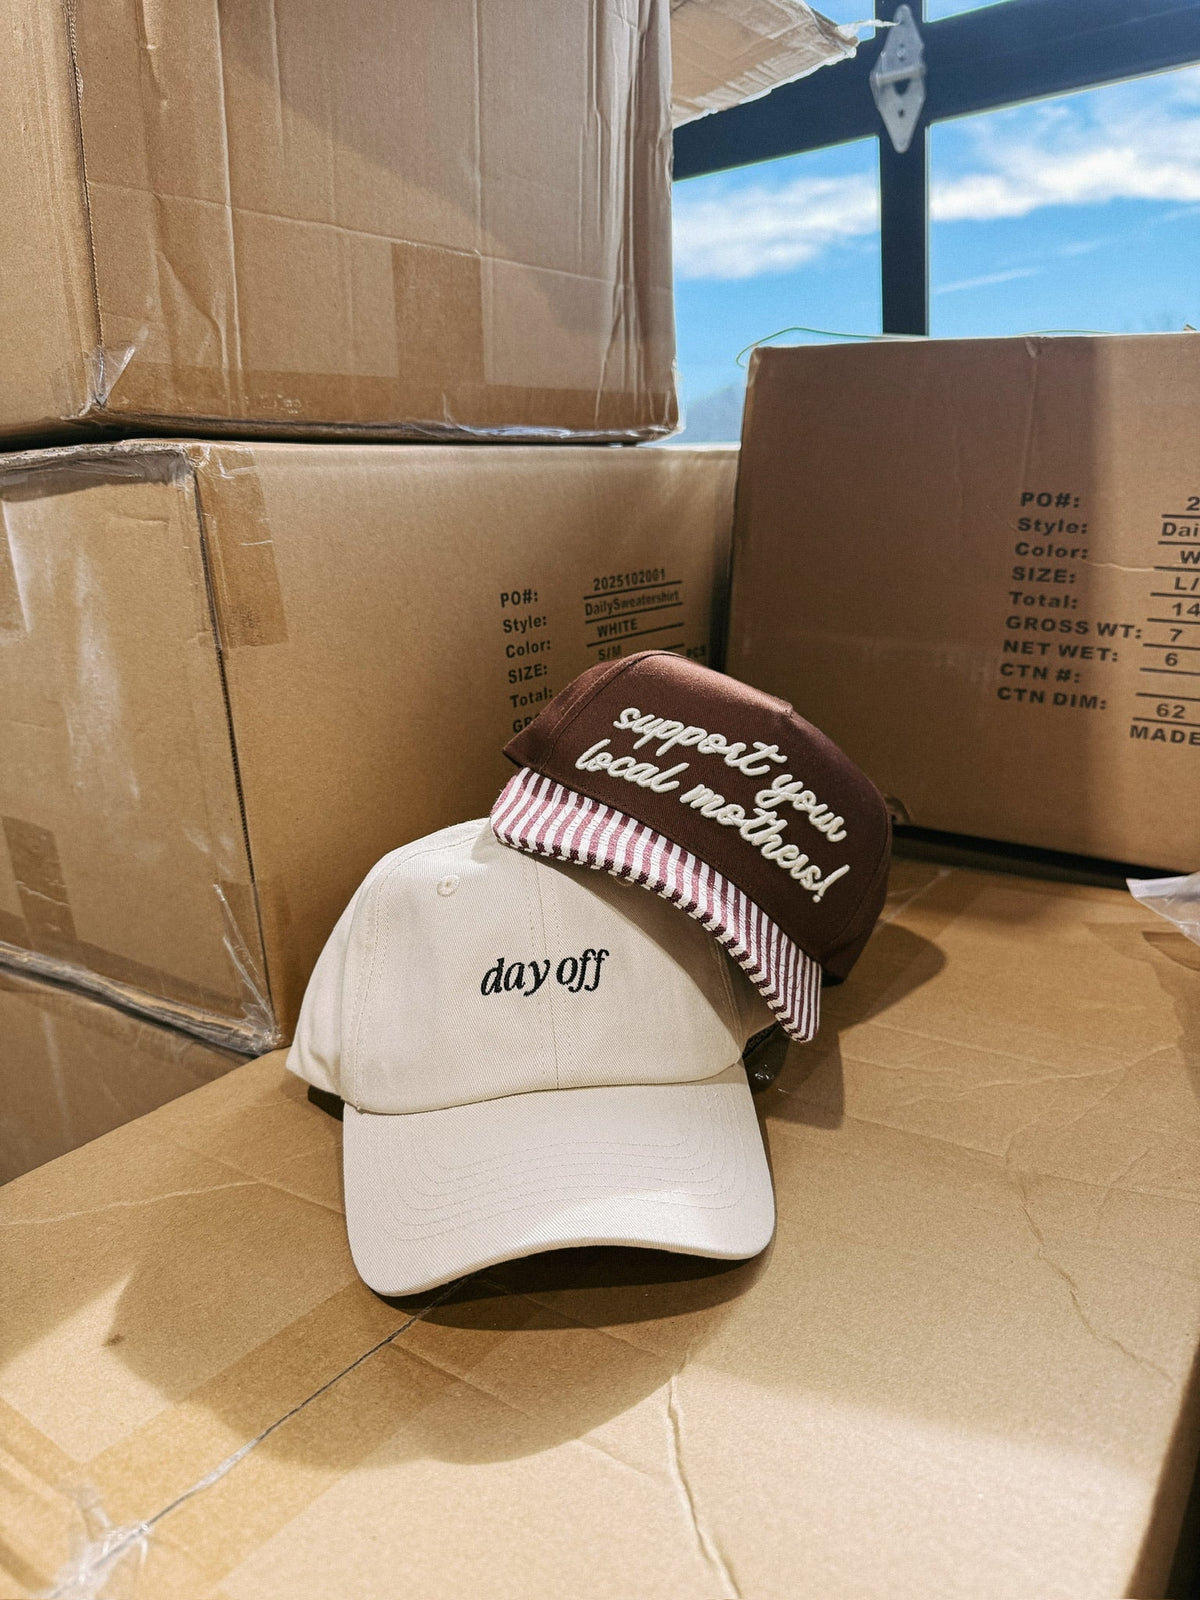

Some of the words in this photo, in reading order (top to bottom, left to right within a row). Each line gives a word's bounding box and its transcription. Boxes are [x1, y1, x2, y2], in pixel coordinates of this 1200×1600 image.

[1020, 491, 1080, 508] PO#:
[1017, 517, 1088, 536] Style:
[1014, 541, 1089, 559] Color:
[1011, 565, 1076, 584] SIZE:
[500, 588, 539, 608] PO#:
[593, 568, 666, 591] 2025102001
[503, 615, 548, 634] Style:
[584, 591, 680, 616] DailySweatershirt
[1008, 591, 1078, 610] Total:
[1171, 602, 1200, 617] 14
[505, 640, 551, 659] Color:
[596, 618, 638, 638] WHITE
[1005, 615, 1089, 635] GROSS
[1096, 621, 1143, 639] WT:
[1169, 628, 1183, 642] 7
[1002, 639, 1051, 656] NET
[1058, 644, 1119, 662] WET:
[1164, 652, 1179, 667] 6
[508, 663, 548, 684] SIZE:
[1000, 662, 1048, 680] CTN
[1055, 668, 1081, 683] #:
[509, 687, 553, 709] Total:
[996, 686, 1045, 704] CTN
[1053, 691, 1107, 710] DIM:
[1155, 703, 1186, 719] 62
[512, 711, 540, 734] GR
[1129, 724, 1200, 746] MADE
[612, 707, 788, 777] support
[754, 773, 848, 843] your
[574, 738, 690, 794] local
[680, 783, 851, 903] mothers!
[480, 957, 551, 997] day
[556, 948, 610, 993] off
